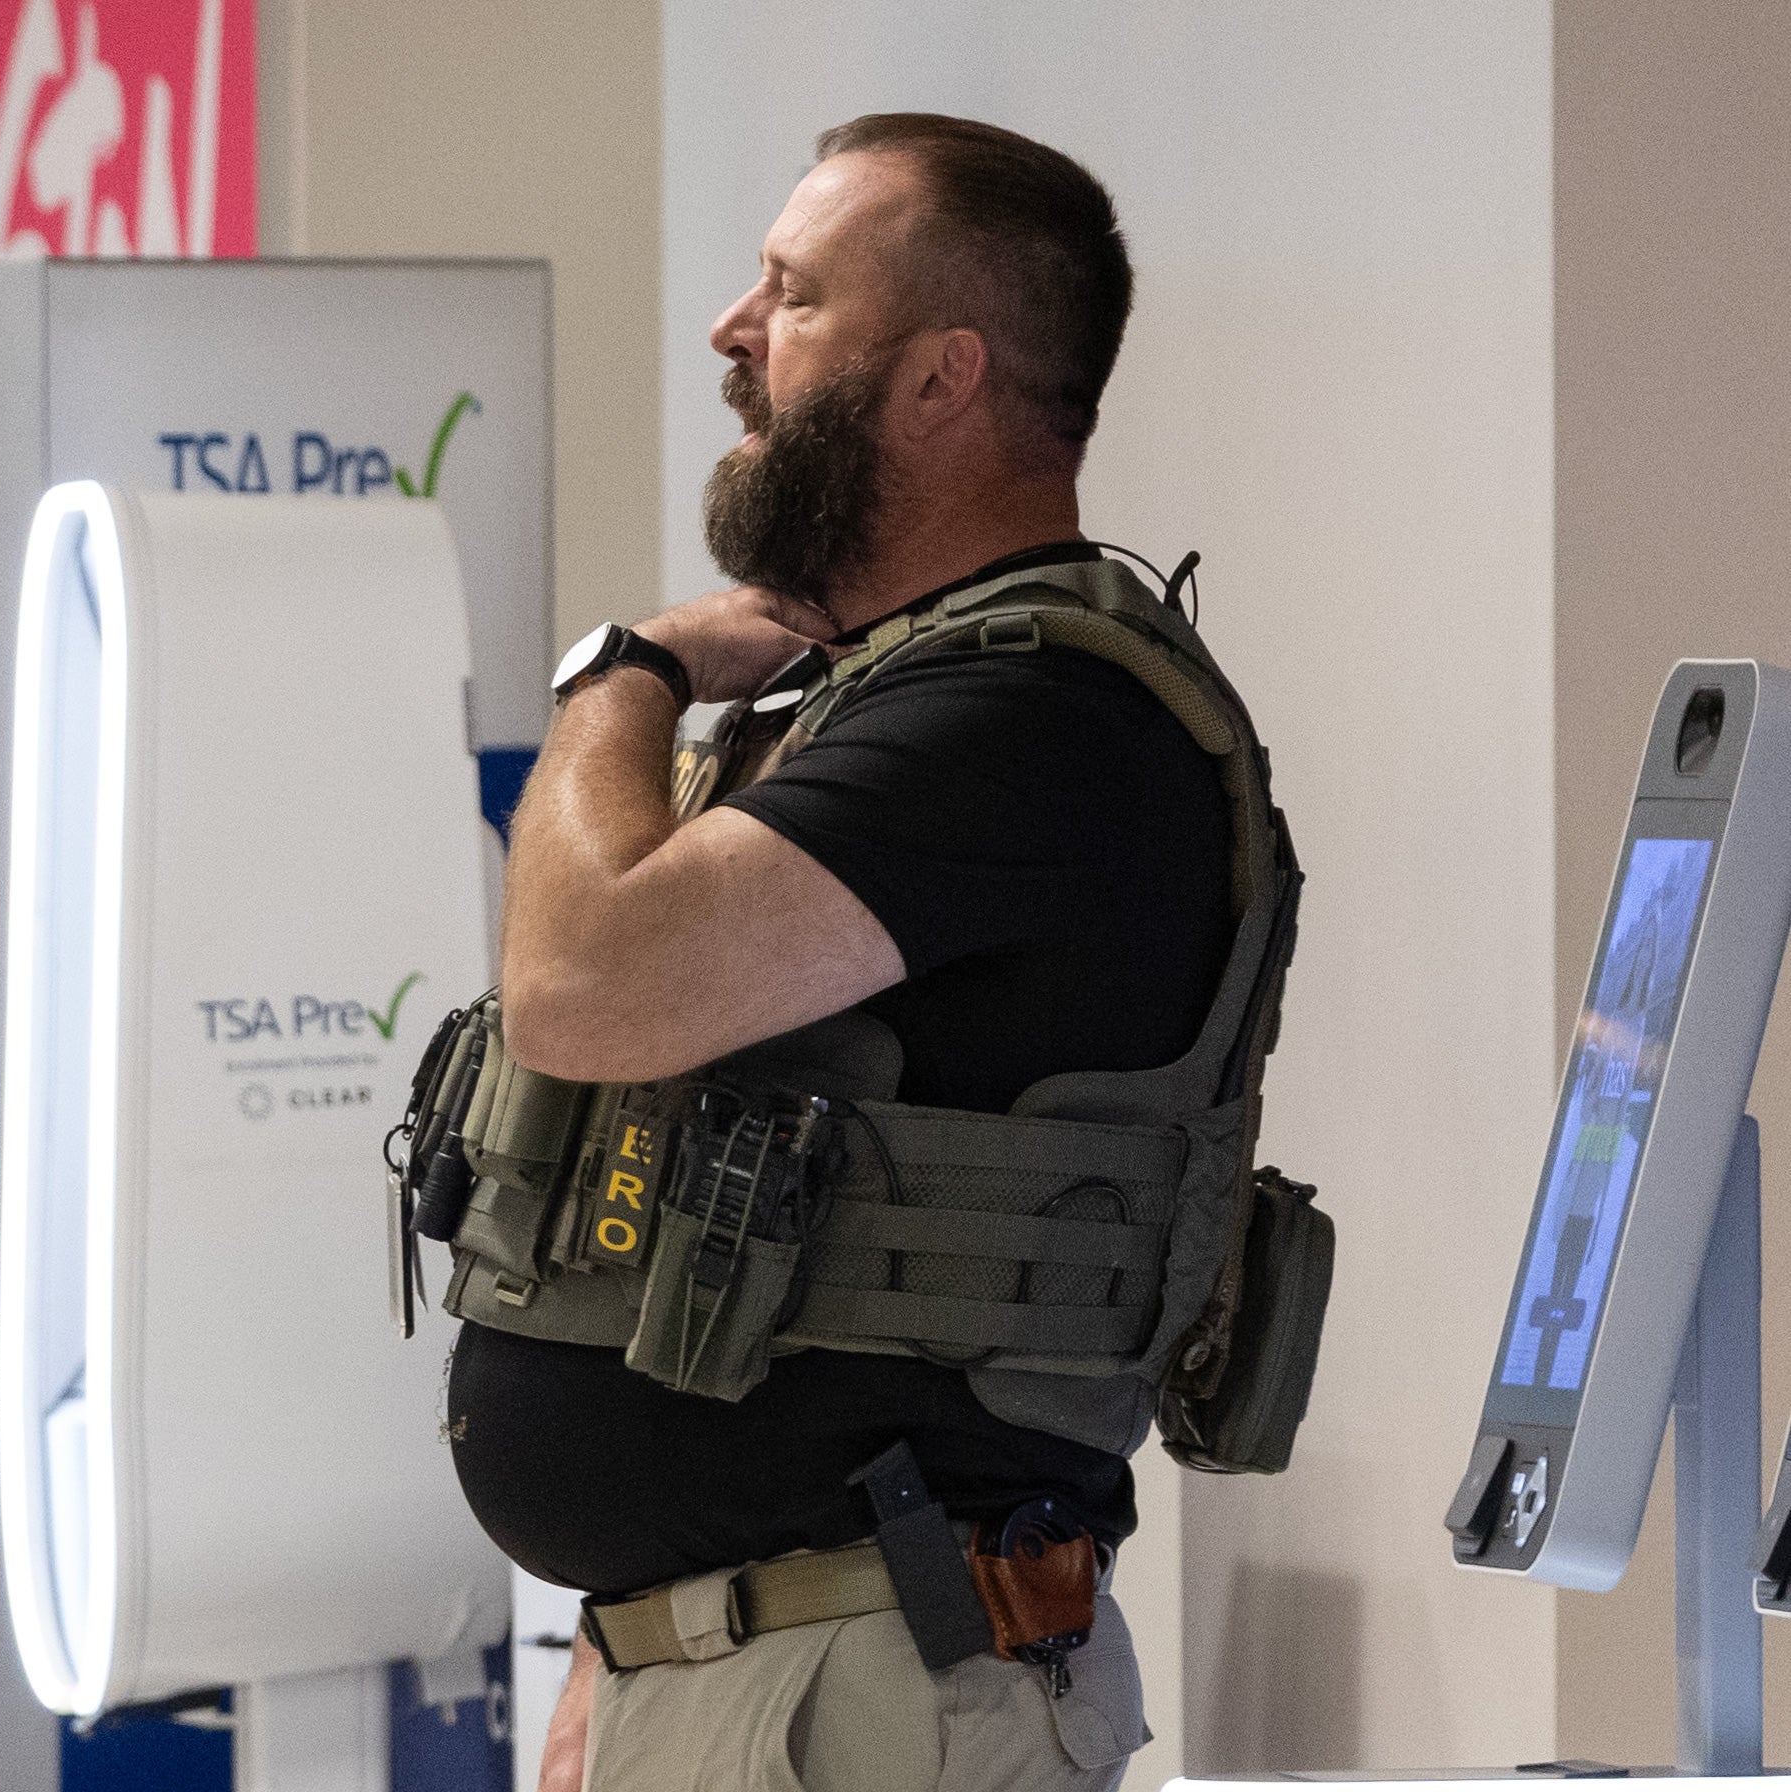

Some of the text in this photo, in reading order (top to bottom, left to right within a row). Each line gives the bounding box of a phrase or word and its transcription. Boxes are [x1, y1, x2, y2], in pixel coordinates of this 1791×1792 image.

[198, 997, 282, 1041] TSA
[288, 1085, 373, 1109] CLEAR
[597, 1125, 652, 1252] ERO
